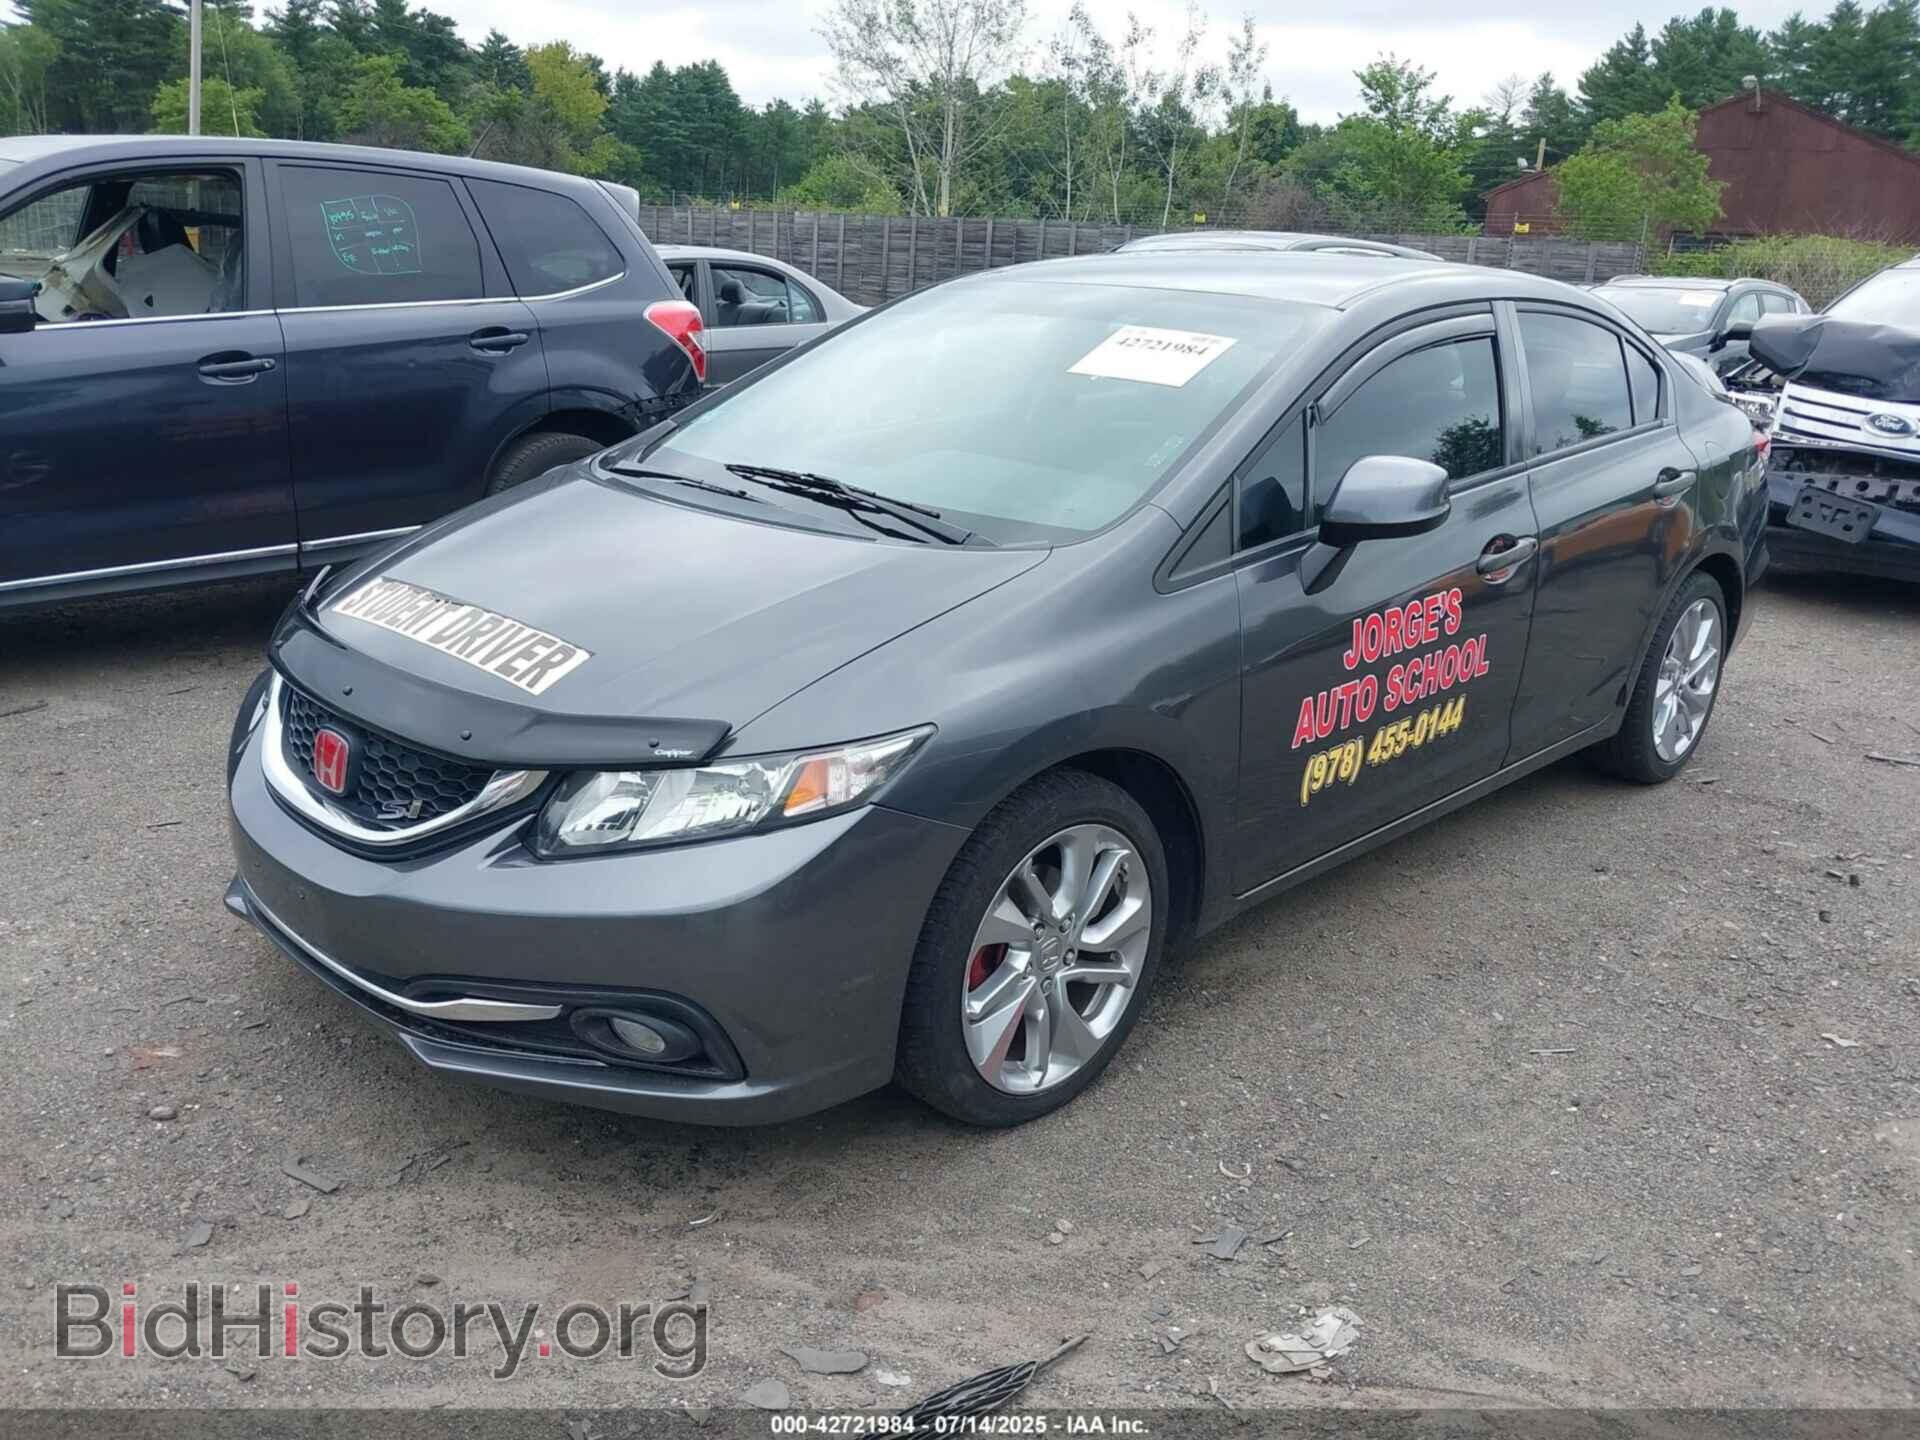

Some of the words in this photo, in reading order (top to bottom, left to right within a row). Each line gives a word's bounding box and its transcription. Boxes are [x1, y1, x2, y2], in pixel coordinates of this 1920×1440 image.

[1117, 336, 1209, 356] 42721984
[1875, 415, 1905, 430] Ford
[342, 582, 460, 635] STUDENT
[427, 608, 577, 689] DRIVER
[1343, 587, 1463, 670] JORGE'S
[1291, 674, 1379, 749] AUTO
[1384, 634, 1490, 711] SCHOOL
[1300, 736, 1366, 807] (978)
[1366, 694, 1467, 767] 455-0144
